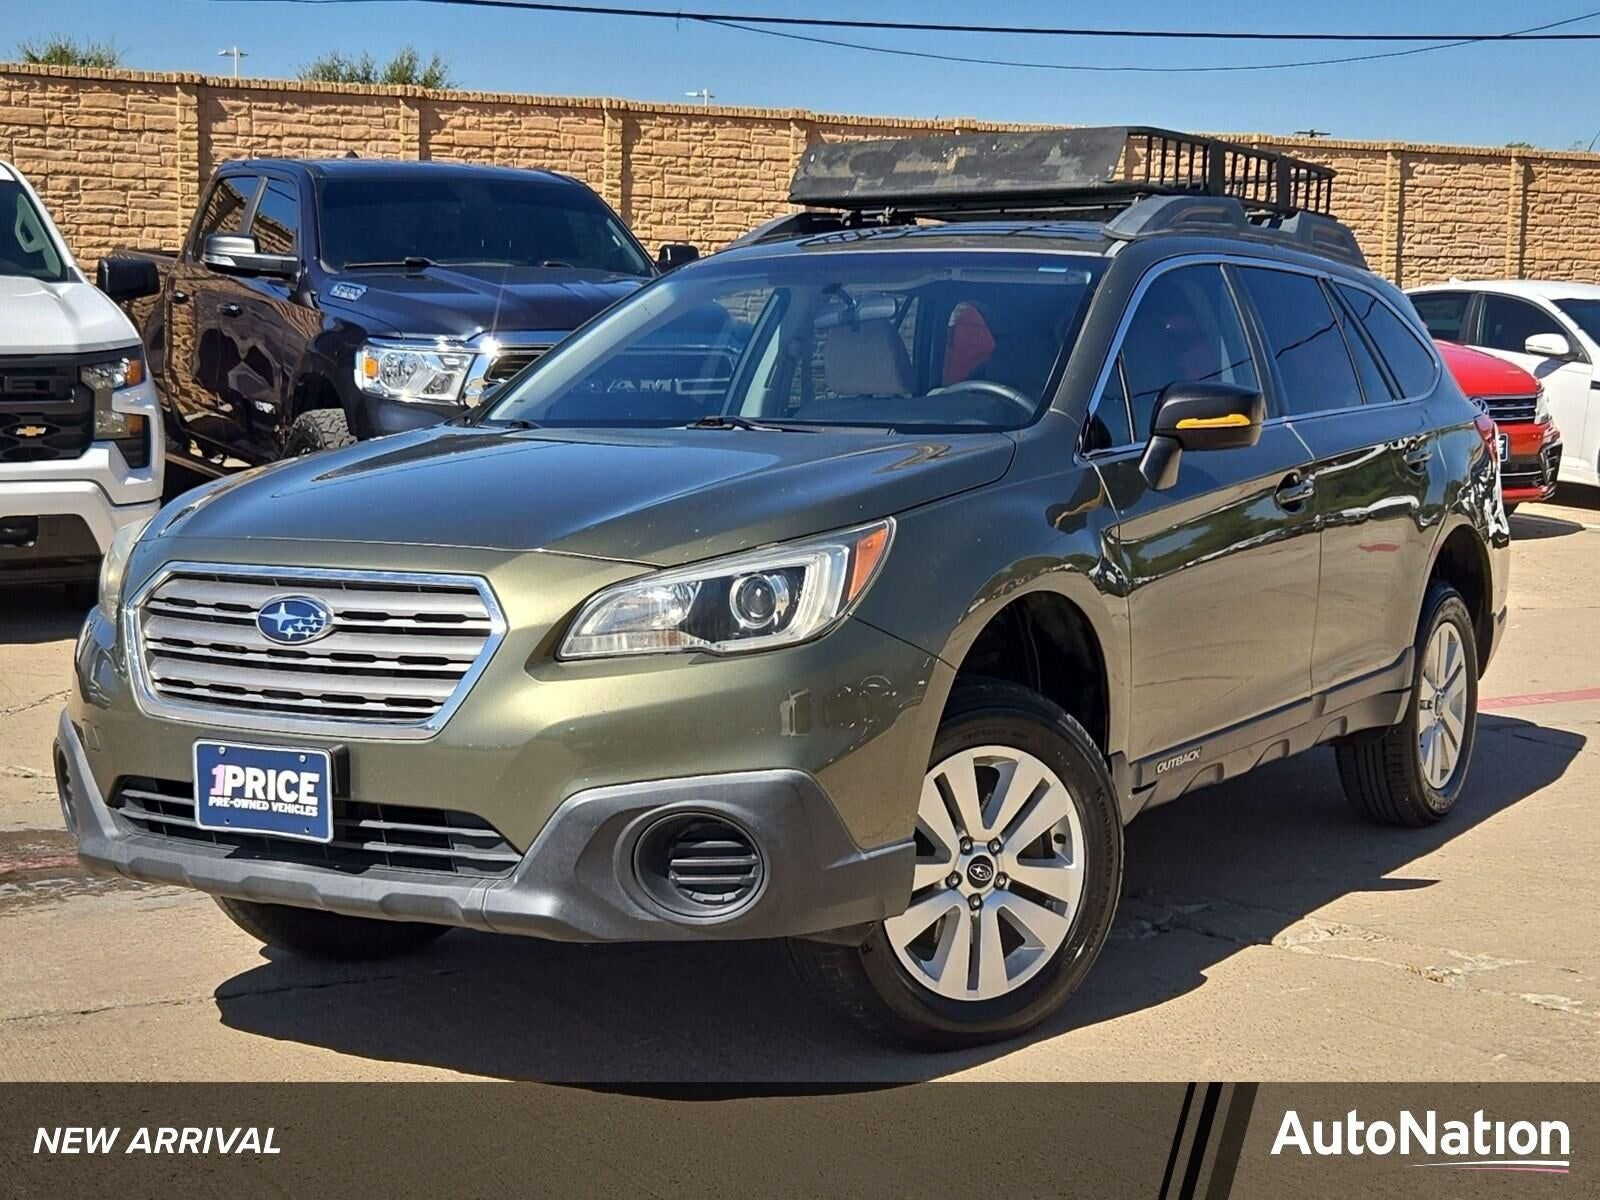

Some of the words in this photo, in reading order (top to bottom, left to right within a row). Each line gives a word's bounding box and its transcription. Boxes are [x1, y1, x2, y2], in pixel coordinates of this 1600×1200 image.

[1157, 748, 1201, 774] OUTBACK
[210, 764, 320, 806] 1PRICE
[208, 796, 270, 811] PRE-OWNED
[270, 801, 318, 817] VEHICLES
